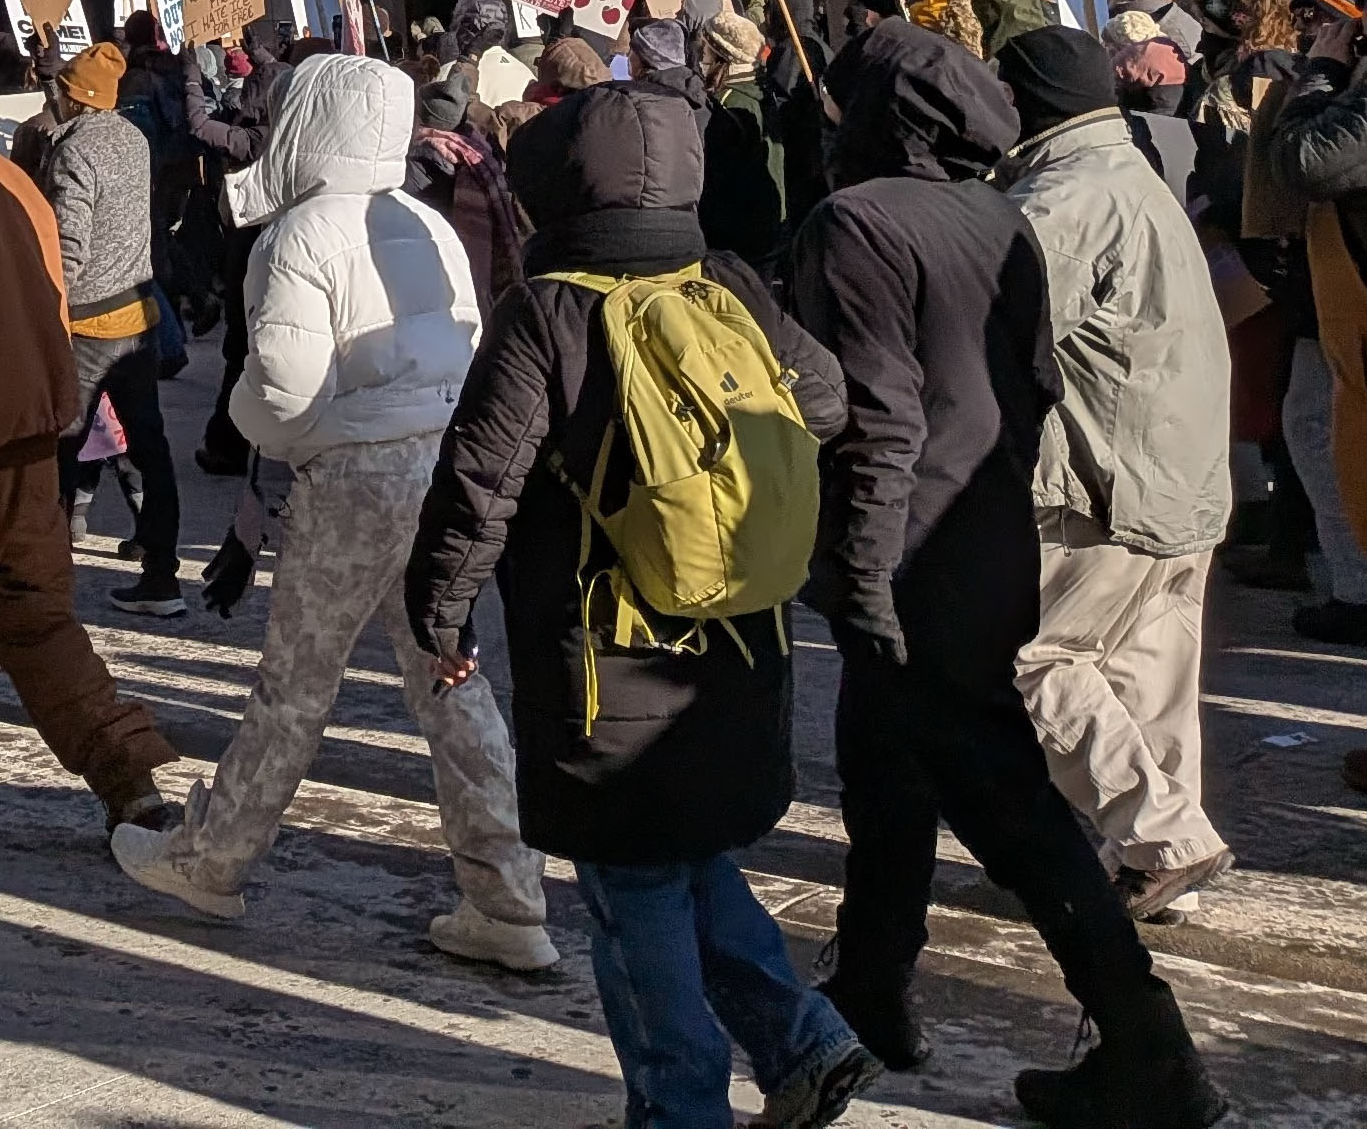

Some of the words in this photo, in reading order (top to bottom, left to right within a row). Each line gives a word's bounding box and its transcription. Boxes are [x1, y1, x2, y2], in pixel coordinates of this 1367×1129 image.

[187, 20, 199, 39] I
[203, 4, 227, 32] HATE
[214, 21, 230, 35] FOR
[231, 6, 254, 26] FREE
[170, 23, 184, 48] NO
[723, 391, 754, 405] deuter
